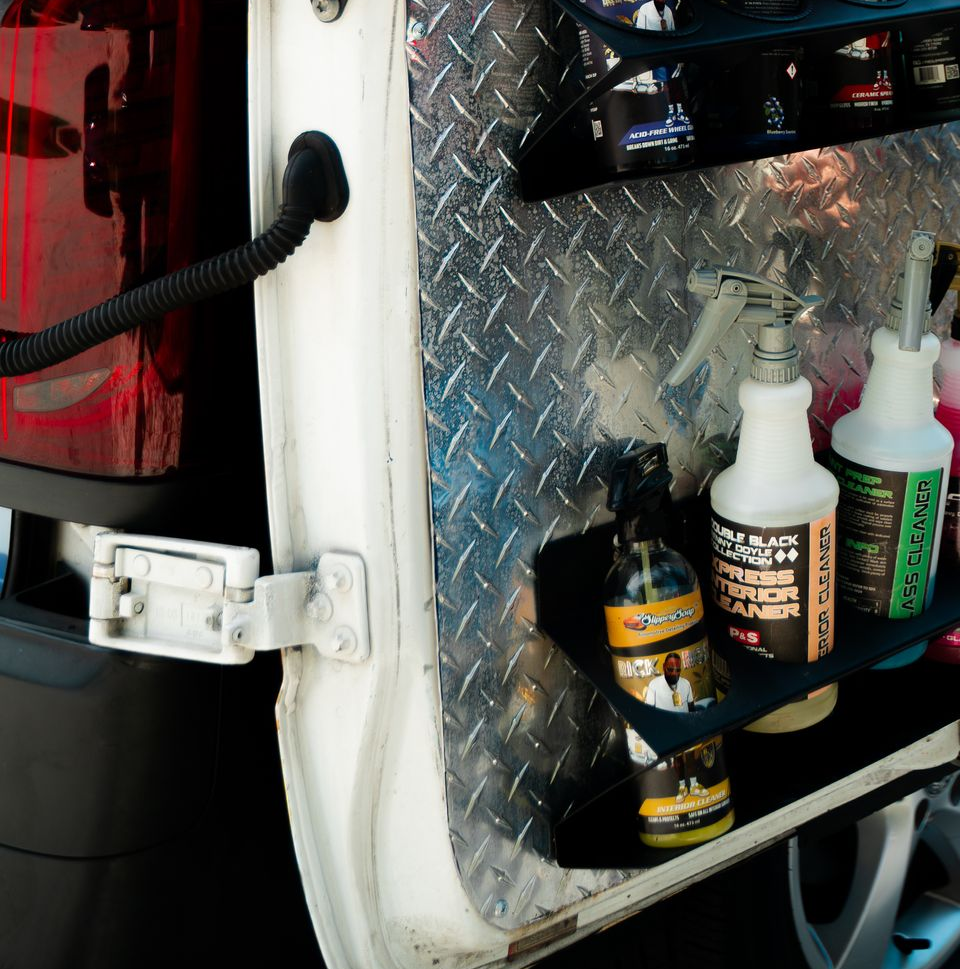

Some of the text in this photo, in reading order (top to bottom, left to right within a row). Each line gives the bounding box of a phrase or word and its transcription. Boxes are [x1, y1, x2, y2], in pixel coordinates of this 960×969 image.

[629, 128, 668, 140] ACID-FREE
[668, 125, 687, 134] WHEEL
[845, 468, 883, 486] PREP
[711, 516, 799, 547] OUBLE BLACK
[712, 539, 773, 565] OLLECTION
[735, 543, 773, 556] DOYLE
[901, 479, 932, 611] ASS CLEANER
[712, 555, 795, 586] XPRESS
[818, 522, 832, 658] ERIOR CLEANER
[641, 607, 696, 626] SlipperySoap
[729, 626, 759, 644] P&S
[617, 657, 661, 678] RICK
[657, 789, 727, 813] INTERIOR CLEANER
